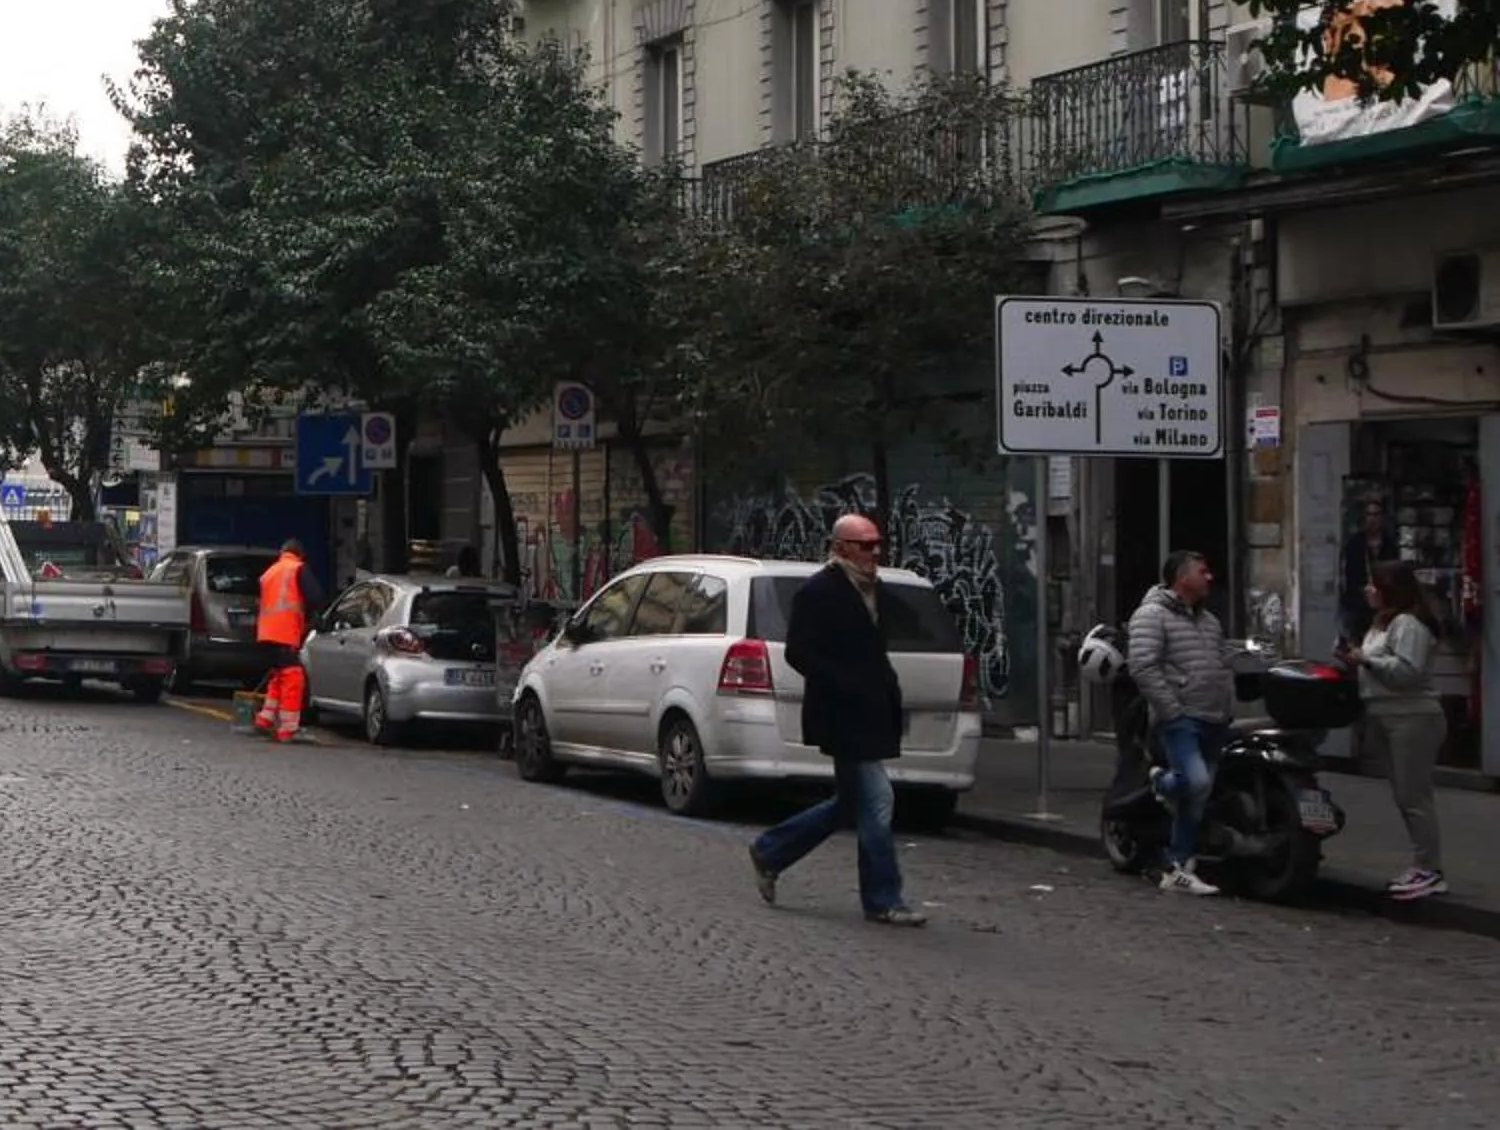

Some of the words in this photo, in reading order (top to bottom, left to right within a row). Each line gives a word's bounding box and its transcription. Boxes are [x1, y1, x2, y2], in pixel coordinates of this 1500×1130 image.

[1025, 309, 1077, 325] centro
[1081, 308, 1170, 327] direzionale
[1012, 380, 1050, 397] piazza
[1121, 382, 1140, 396] via
[1143, 378, 1208, 400] Bologna
[1013, 400, 1088, 420] Garibaldi
[1137, 407, 1155, 421] via
[1159, 403, 1208, 422] Torino
[1133, 432, 1151, 446] via
[1155, 428, 1208, 447] Milano
